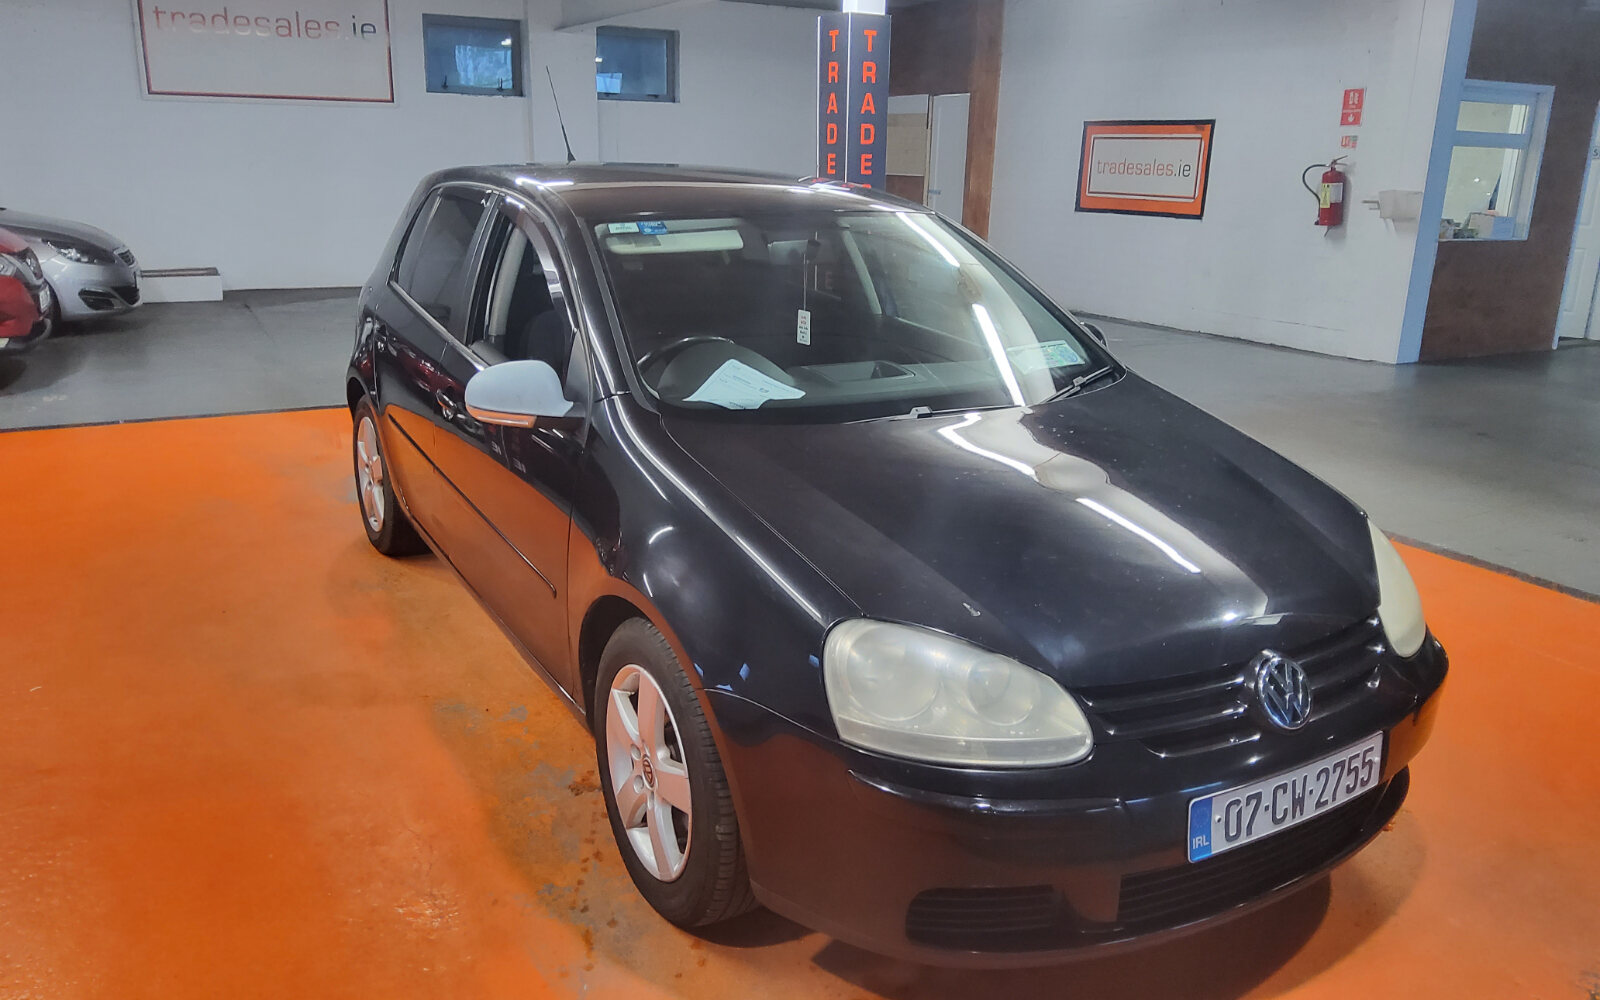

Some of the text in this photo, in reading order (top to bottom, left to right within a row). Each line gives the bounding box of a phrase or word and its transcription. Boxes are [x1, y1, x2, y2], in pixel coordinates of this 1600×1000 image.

[826, 29, 839, 175] TRADE
[860, 29, 878, 188] TRADE
[1097, 157, 1191, 178] tradesales.ie
[1192, 835, 1210, 850] IRL
